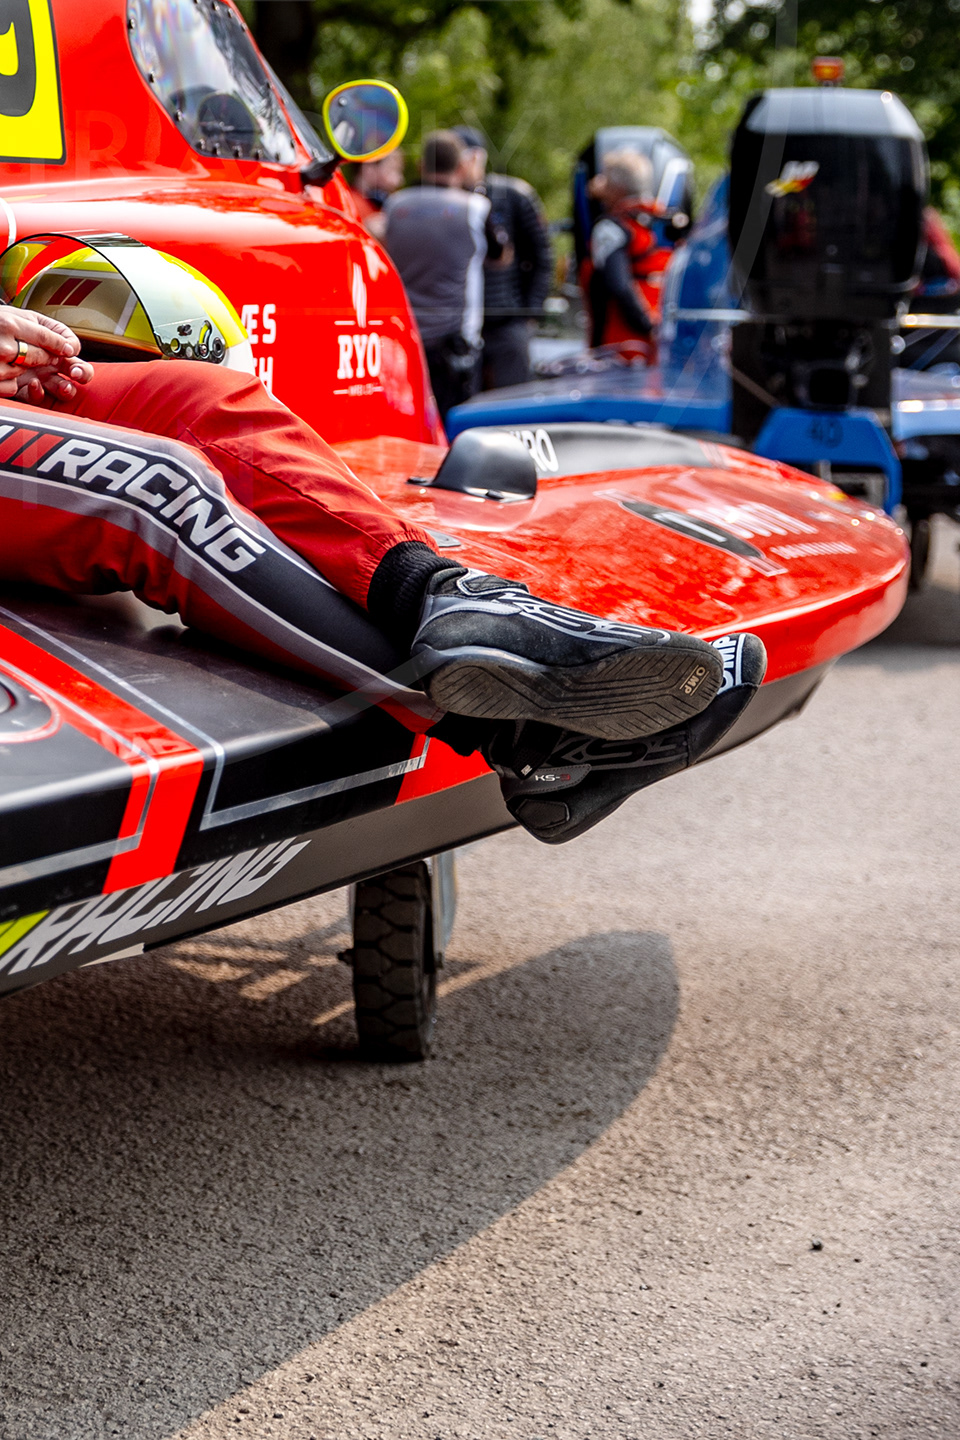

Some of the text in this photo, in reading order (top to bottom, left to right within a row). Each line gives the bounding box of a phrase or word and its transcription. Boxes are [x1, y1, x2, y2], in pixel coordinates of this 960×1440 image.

[336, 332, 383, 380] RYO
[683, 665, 707, 695] OMP
[534, 773, 572, 783] KS-3
